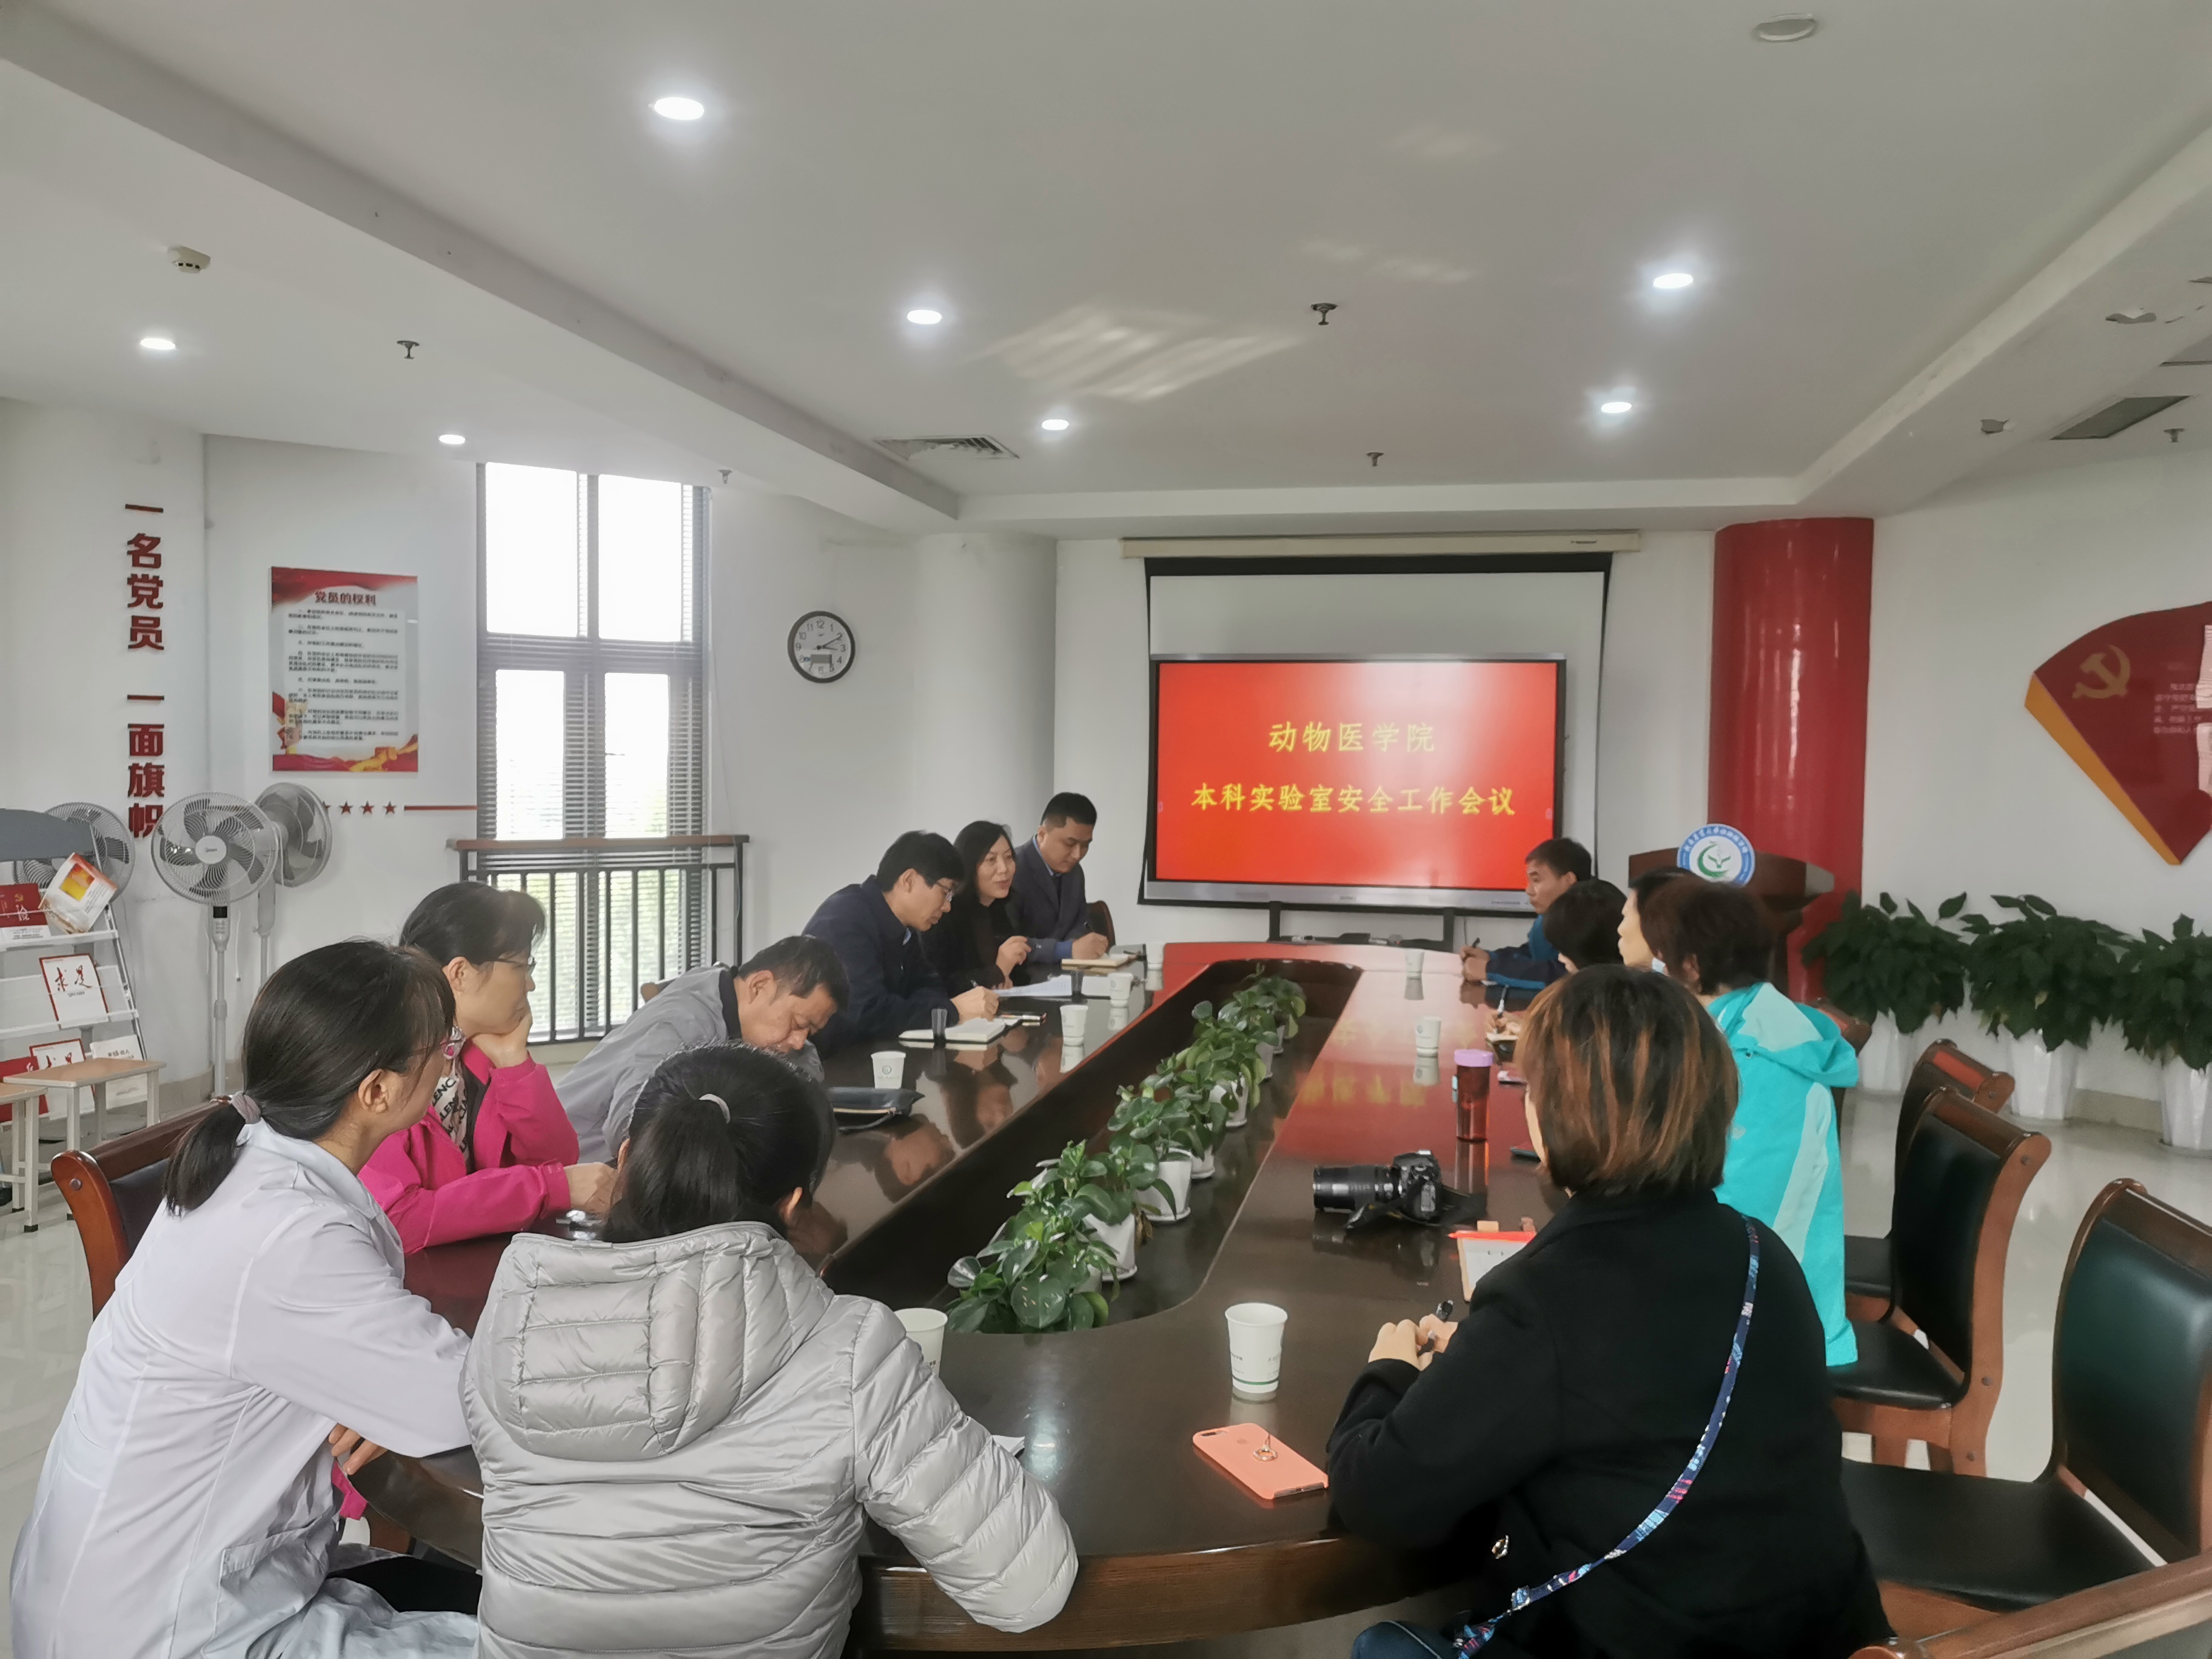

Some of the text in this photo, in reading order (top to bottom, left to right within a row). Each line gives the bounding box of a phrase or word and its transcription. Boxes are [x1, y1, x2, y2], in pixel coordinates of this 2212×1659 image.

[314, 591, 377, 606] 党员的权利
[125, 503, 165, 839] 一名党员 一面旗帜
[1268, 721, 1435, 752] 动物医学院
[1191, 783, 1516, 816] 本科实验室安全工作会议
